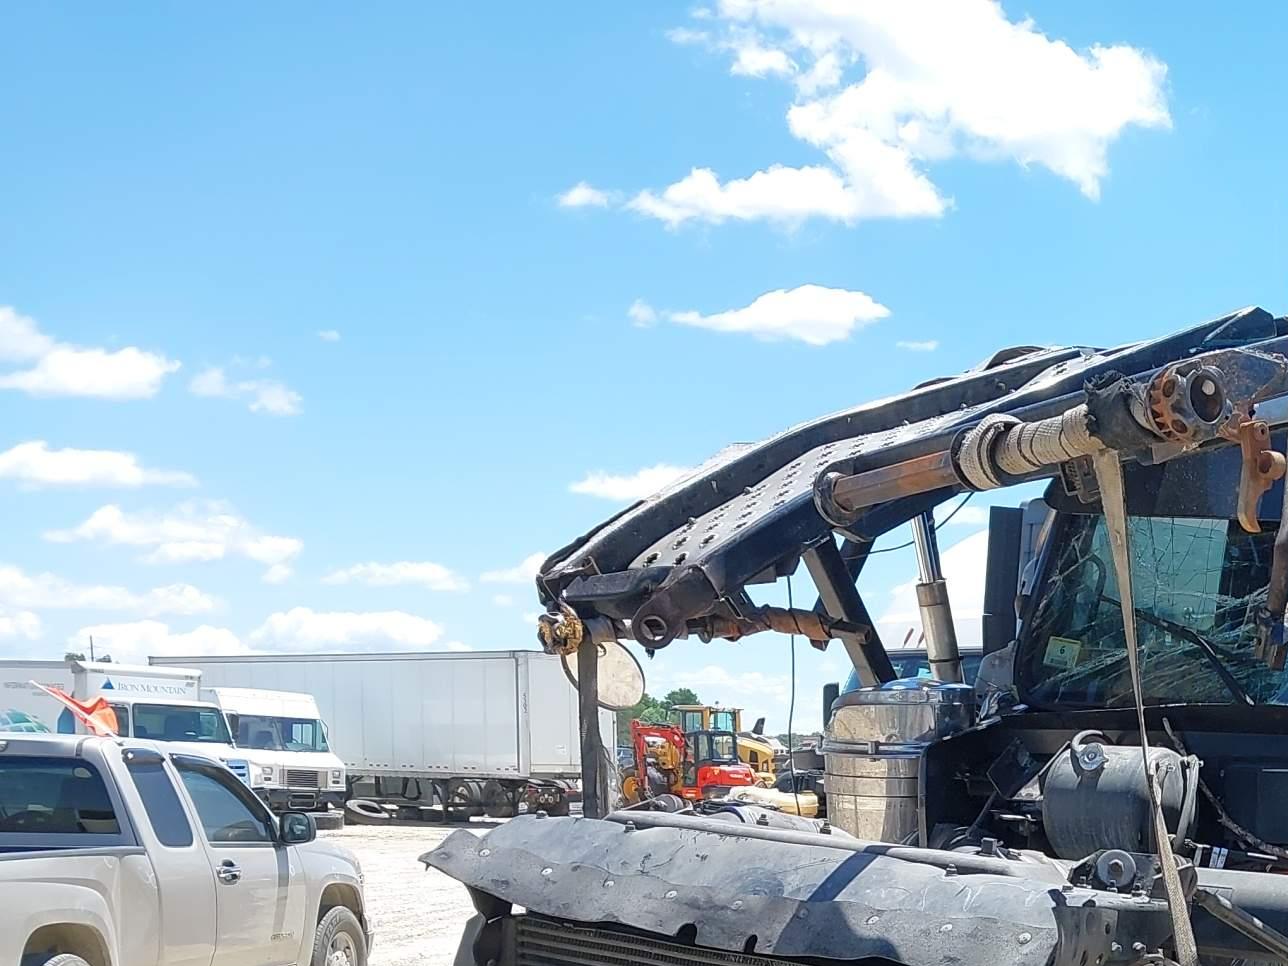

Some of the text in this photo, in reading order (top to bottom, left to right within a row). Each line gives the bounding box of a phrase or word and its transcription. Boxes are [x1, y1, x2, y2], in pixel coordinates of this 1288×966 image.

[1059, 645, 1066, 655] 6
[118, 682, 187, 695] IRON MOUNTAIN
